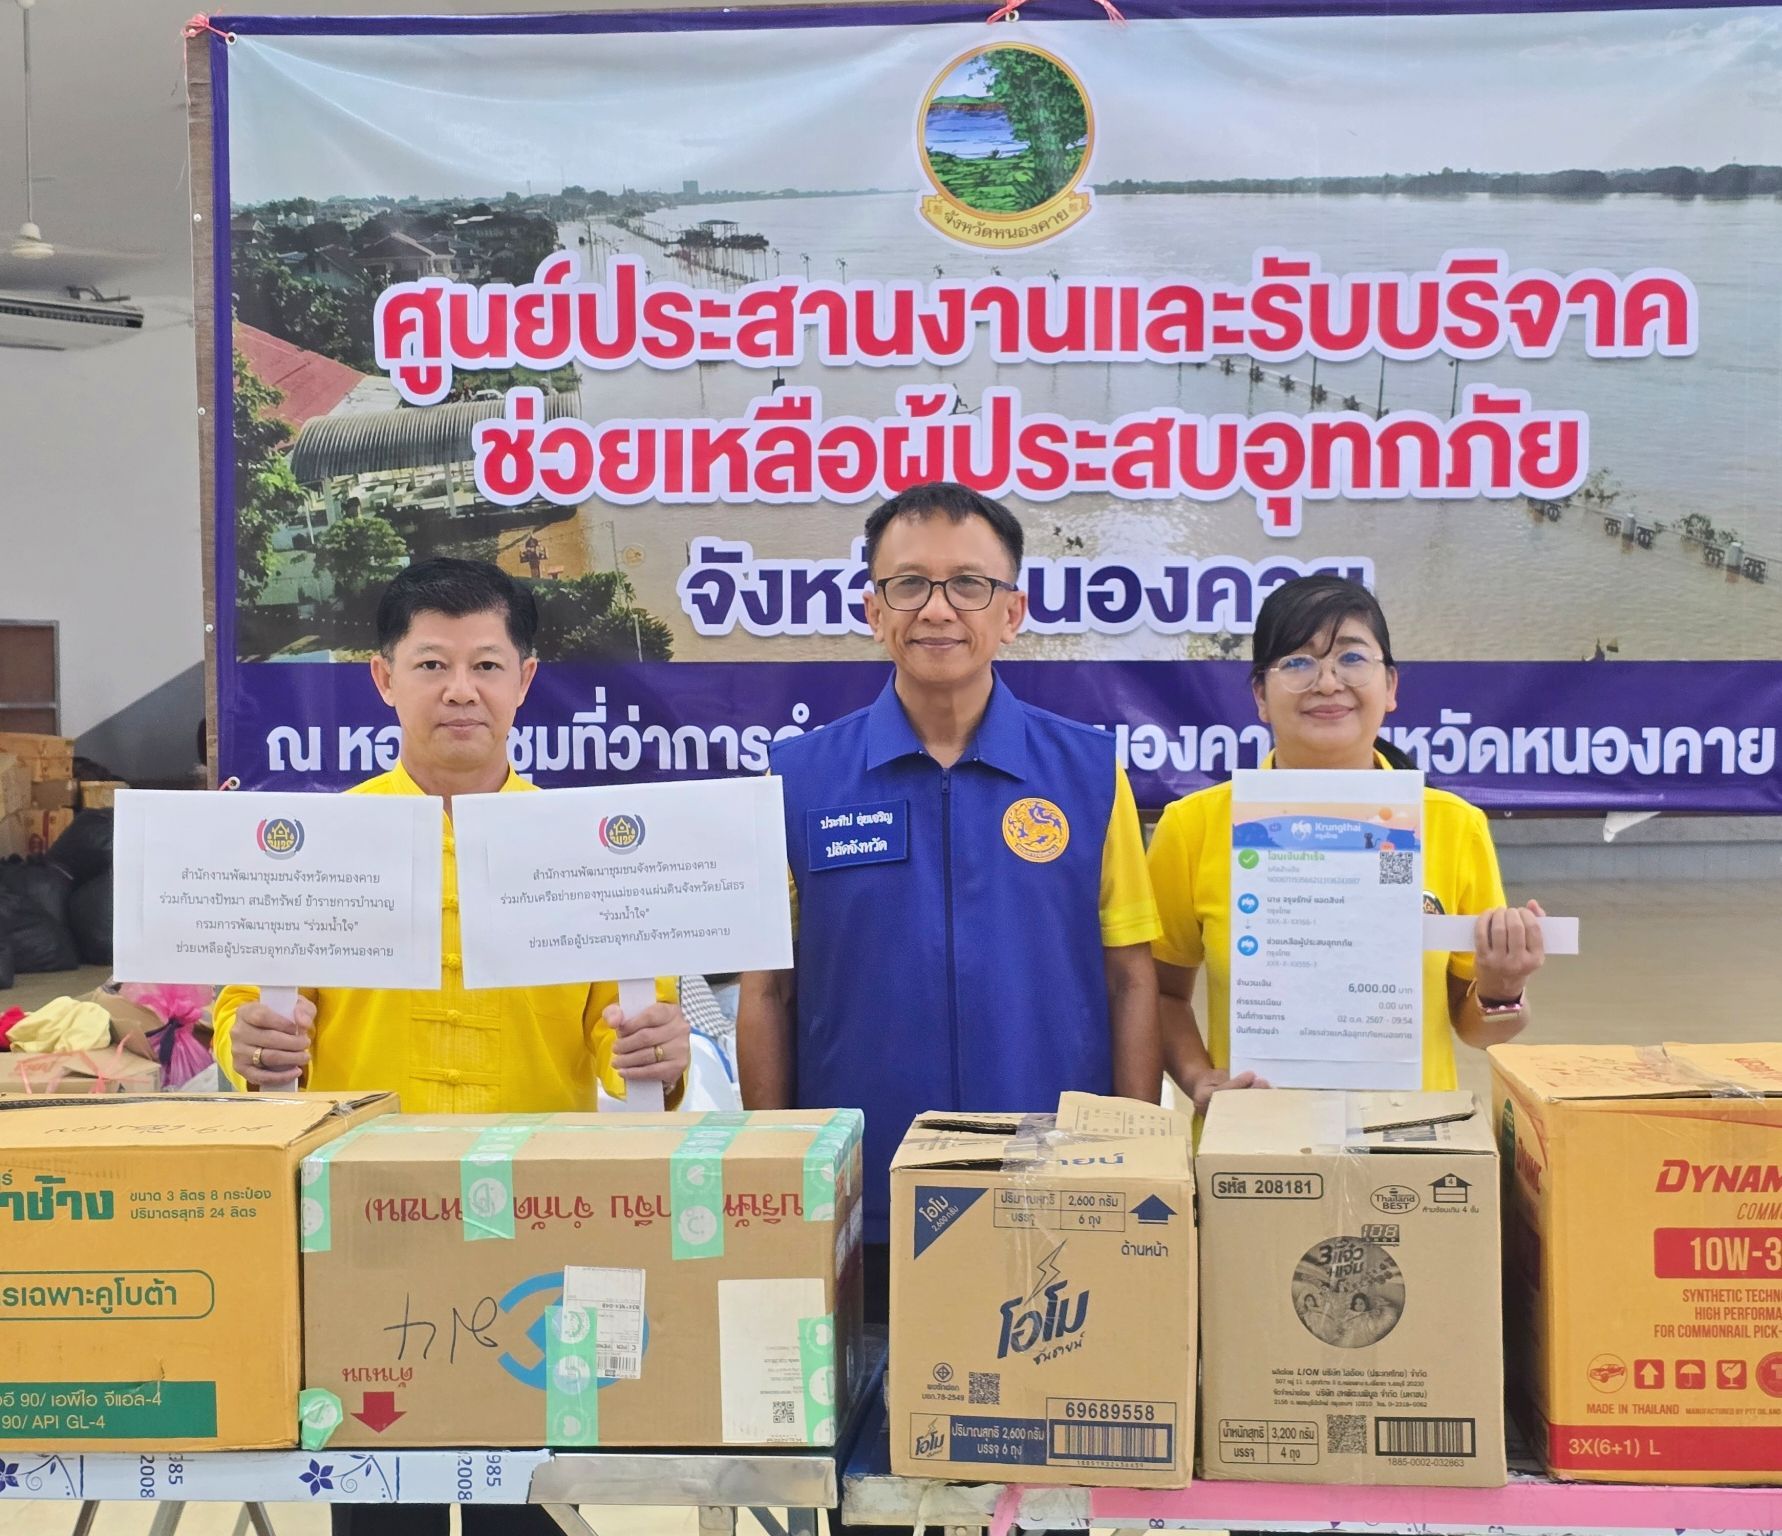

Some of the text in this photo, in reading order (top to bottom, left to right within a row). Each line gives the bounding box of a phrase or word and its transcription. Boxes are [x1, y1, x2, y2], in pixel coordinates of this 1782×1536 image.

[944, 209, 1069, 240] จังหวัดหนองคาย
[383, 257, 1688, 394] ศูนย์ประสานงานและรับบริจาค
[482, 393, 1578, 526] ช่วยเหลือผ้ประสบอุทกภัย
[266, 725, 321, 771] ณ
[1314, 822, 1361, 833] Krungthai
[182, 868, 380, 885] สำนักงานพัฒนาชุมชนจังหวัดหนองคาย
[533, 859, 717, 881] สำนักงานพัฒนาชุมชนจังหวัดหนองคาย
[196, 919, 299, 934] กรมการพัฒนาชุมชน
[529, 926, 731, 949] ช่วยเหลือผู้ประสบอุทกภัยจังหวัดหนองคาย
[176, 942, 394, 959] ช่วยเหลือผู้ประสบอุทกภัยจังหวัดหนองคาย
[1348, 983, 1396, 994] 6,000.00
[1378, 1002, 1396, 1010] 0.00
[1217, 1175, 1313, 1195] รหัส 208181
[1447, 1177, 1454, 1185] 4
[130, 1191, 162, 1202] ขนาด
[166, 1190, 175, 1201] 3
[180, 1189, 206, 1201] ลิตร
[210, 1189, 218, 1201] 8
[1068, 1195, 1096, 1207] 2,600
[1099, 1193, 1119, 1207] กรัม
[1374, 1193, 1416, 1203] Thailand
[130, 1205, 257, 1222] ปริมาตรสุทธิ 24 ลิตร
[919, 1195, 949, 1223] โอโม
[1382, 1202, 1410, 1210] BEST
[1462, 1205, 1468, 1213] 4
[1736, 1202, 1782, 1221] COMM
[1078, 1213, 1085, 1225] 6
[1088, 1215, 1101, 1228] ถุง
[1363, 1225, 1398, 1238] 108
[1121, 1239, 1169, 1257] ด้านหน้า
[1690, 1237, 1782, 1271] 10W-3
[1682, 1288, 1782, 1303] SYNTHETIC TECHN
[997, 1280, 1090, 1360] โอโม
[1695, 1306, 1721, 1321] HIGH
[1654, 1324, 1675, 1338] FOR
[1678, 1324, 1751, 1338] COMMONRAIL
[342, 1367, 413, 1388] ด้านบน
[20, 1392, 47, 1408] 90/
[51, 1389, 98, 1407] เอพีไอ
[104, 1390, 162, 1407] จีแอล-4
[1065, 1401, 1155, 1421] 69689558
[1586, 1403, 1615, 1415] MADE
[1618, 1403, 1629, 1415] IN
[1632, 1404, 1680, 1415] THAILAND
[2, 1414, 106, 1430] 90/ API GL-4
[951, 1423, 1045, 1442] ปริมาณสุทธิ 2,600 กรัม
[1222, 1421, 1315, 1442] น้ำหนักสุทธิ 3,200 กรัม
[914, 1430, 945, 1456] โอโม
[977, 1443, 1000, 1458] บรรจุ
[1002, 1444, 1008, 1455] 6
[1568, 1438, 1661, 1458] 3X(6+1) L
[1233, 1447, 1255, 1461] บรรจุ
[1280, 1446, 1287, 1458] 4
[140, 1454, 155, 1499] 2008
[457, 1453, 472, 1501] 2008
